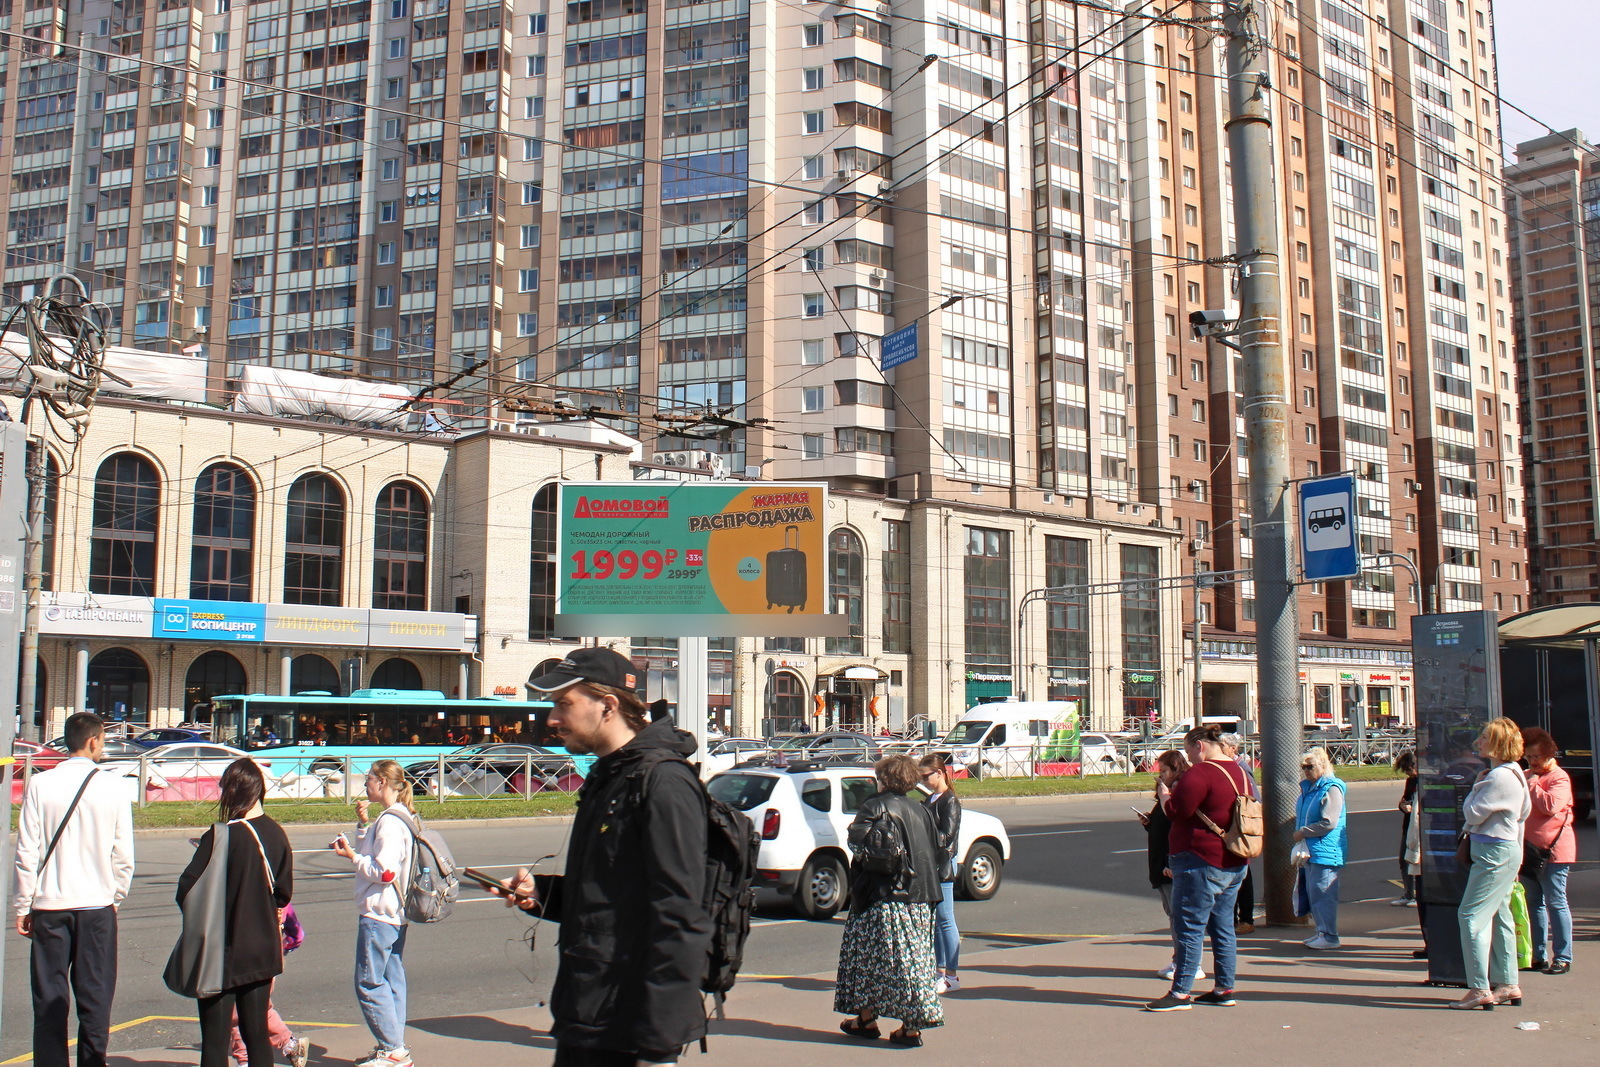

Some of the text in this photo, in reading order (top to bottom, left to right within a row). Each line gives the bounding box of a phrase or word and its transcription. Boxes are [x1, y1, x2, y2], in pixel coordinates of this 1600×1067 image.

[752, 491, 810, 508] ЖАРКАЯ
[688, 506, 815, 532] РАСПРОДАЖА
[570, 530, 650, 539] ЧЕМОДАН ДОРОЖНЫЙ
[65, 608, 144, 623] ГАЗПРОМБАНК
[191, 612, 225, 620] EXPRESS
[191, 620, 257, 632] КОПИЦЕНТР
[274, 615, 447, 636] ЛИНДФОРС ПИРОГИ
